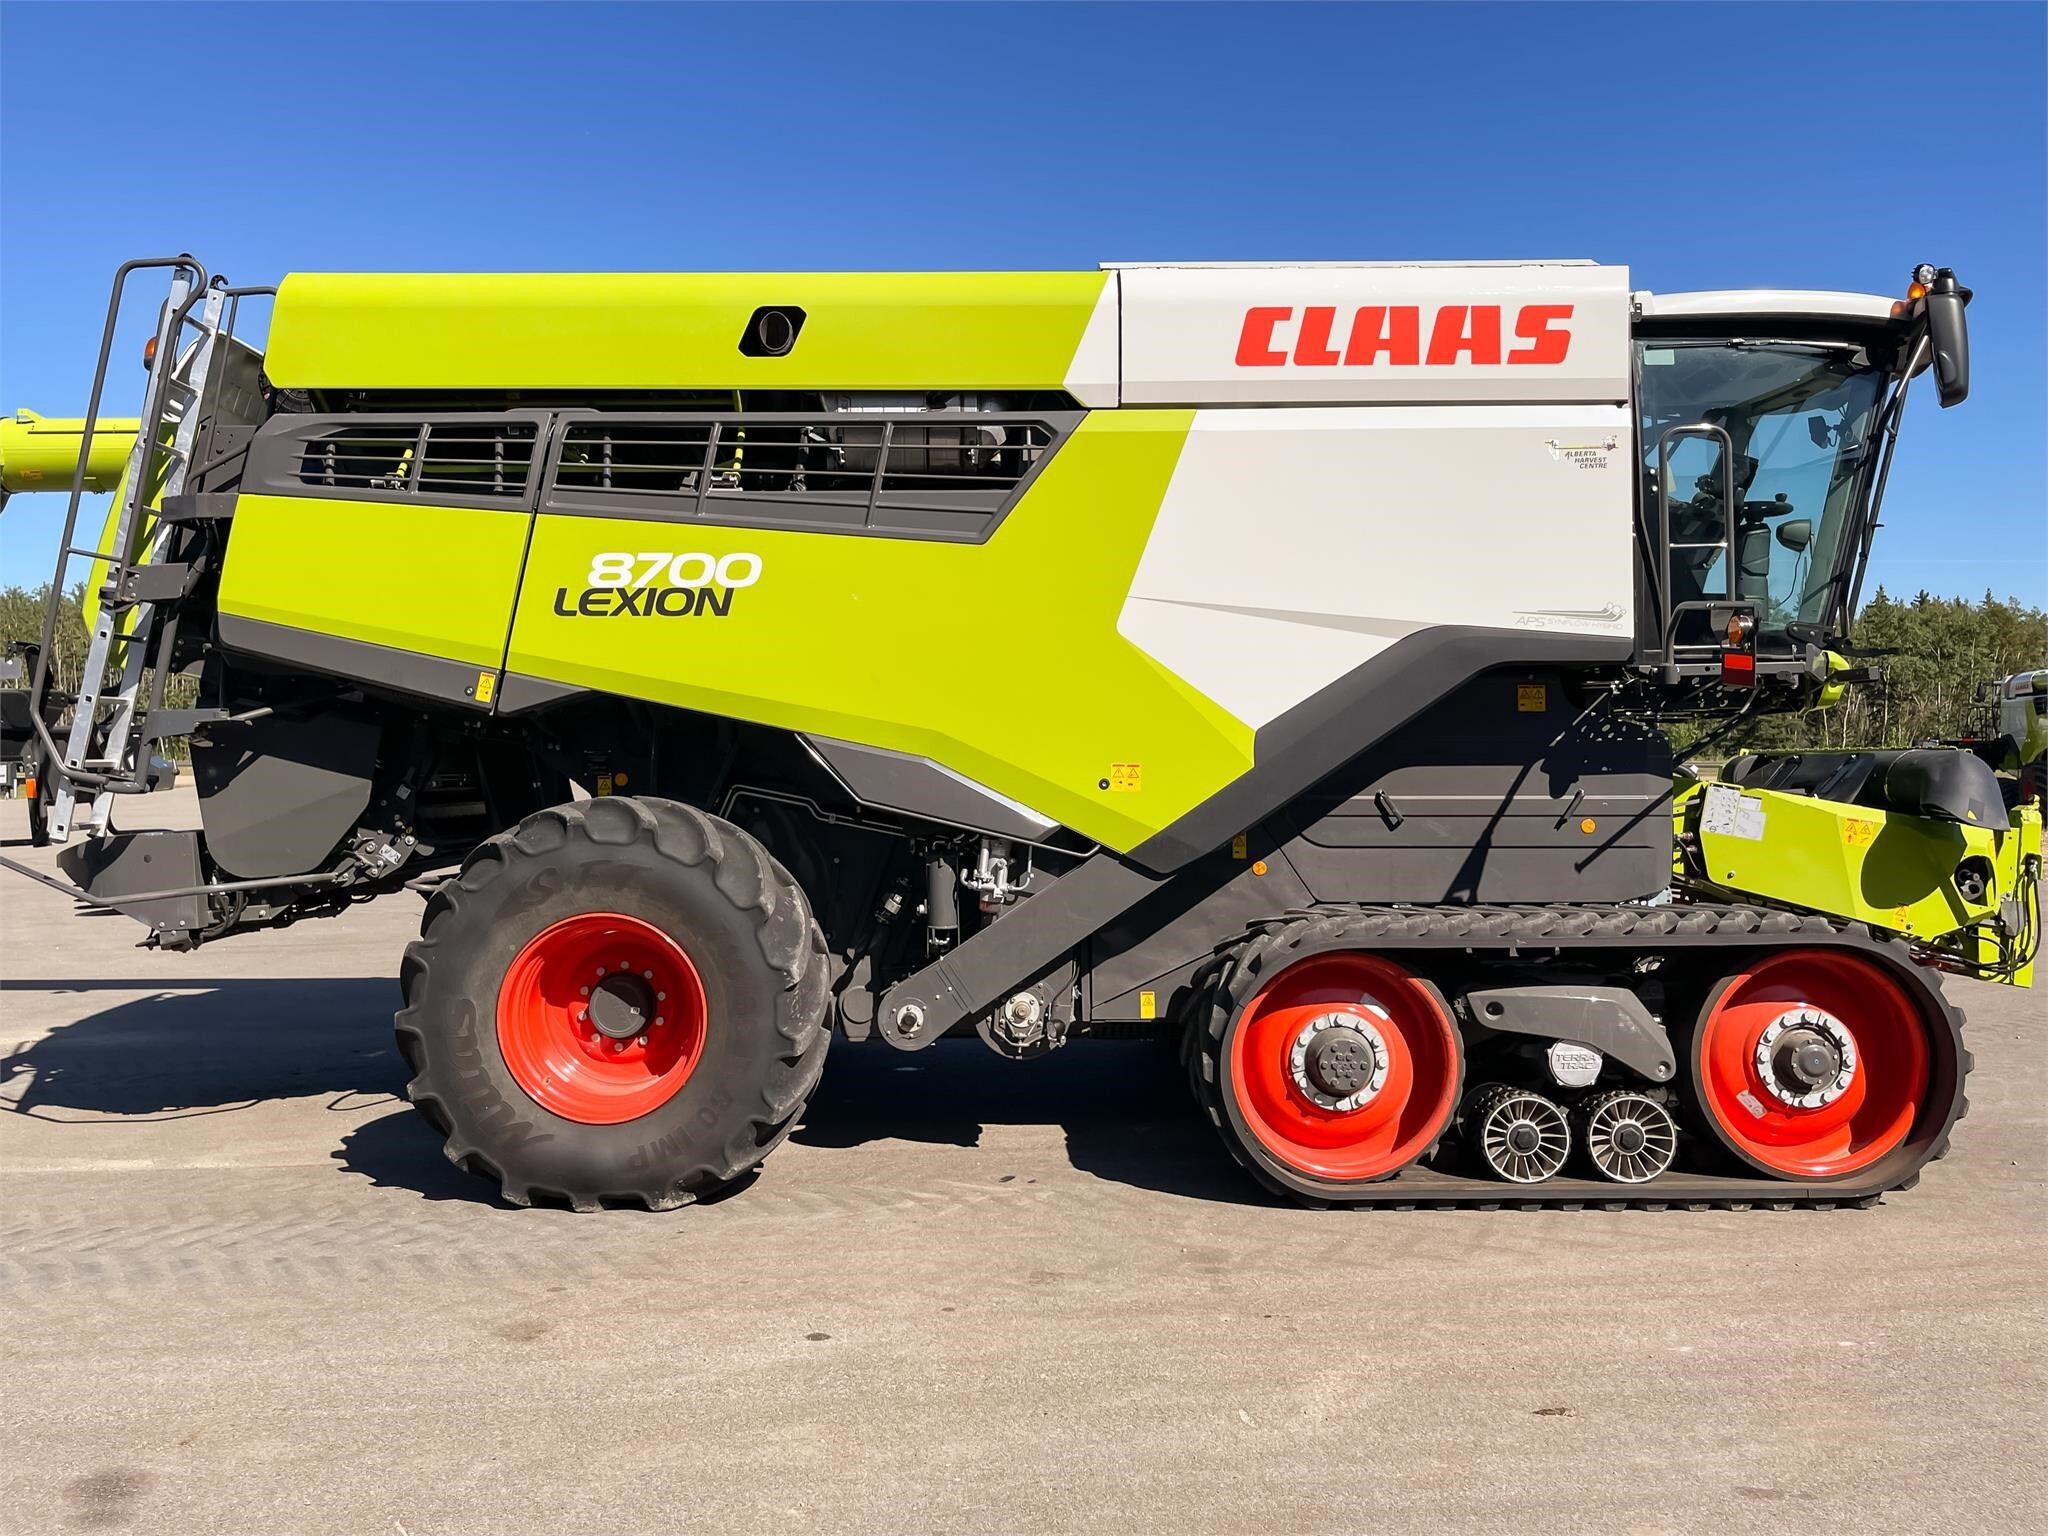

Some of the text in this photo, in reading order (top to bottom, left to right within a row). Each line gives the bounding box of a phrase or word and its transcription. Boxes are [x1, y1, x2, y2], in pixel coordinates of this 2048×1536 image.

[1235, 304, 1574, 366] CLAAS
[587, 552, 763, 588] 8700
[553, 587, 735, 617] LEXION
[1515, 615, 1546, 627] APS
[1556, 1054, 1597, 1062] TERRA
[1560, 1062, 1594, 1070] TRAC
